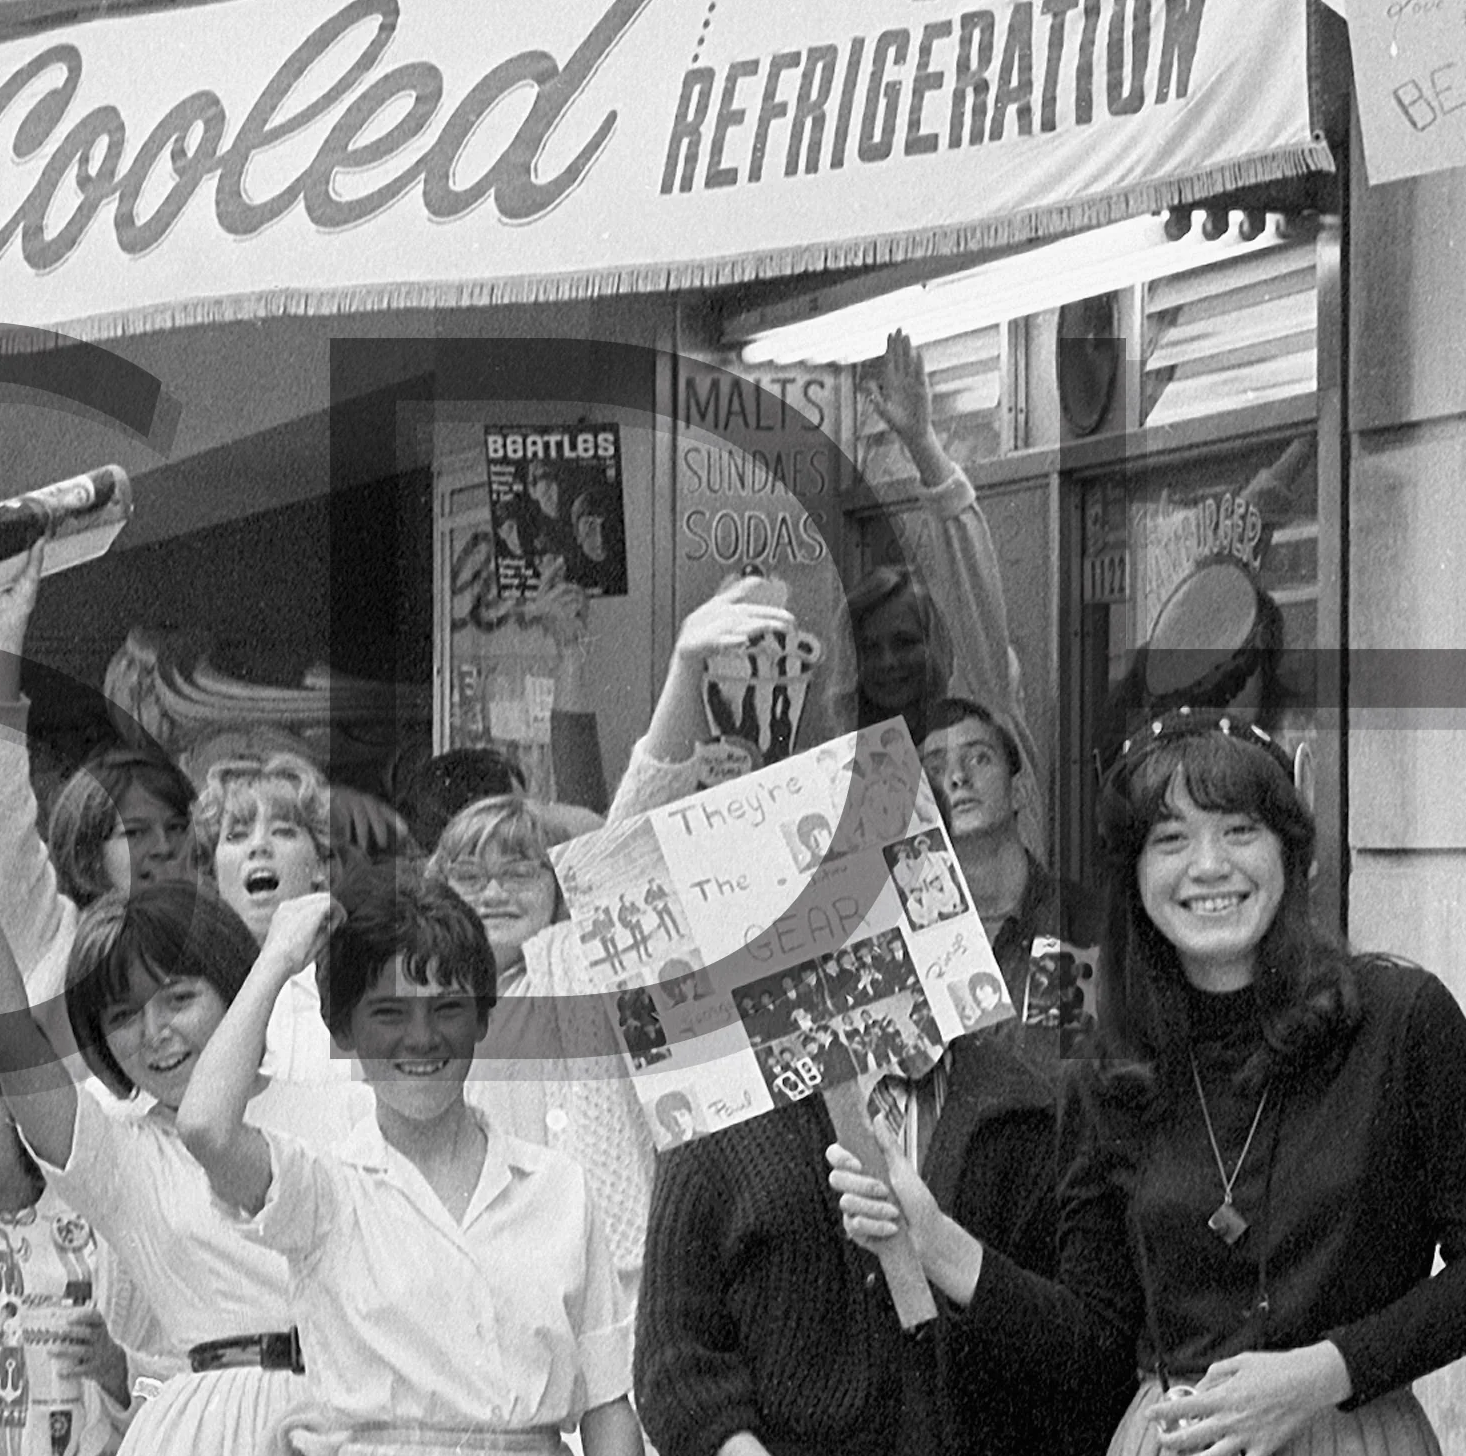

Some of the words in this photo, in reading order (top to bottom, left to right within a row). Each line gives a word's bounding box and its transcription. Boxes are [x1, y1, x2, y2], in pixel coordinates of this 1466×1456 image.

[684, 375, 828, 433] MALTS
[486, 432, 616, 460] BEATLES
[683, 447, 830, 499] SUNDAES
[683, 509, 830, 566] SODAS
[668, 773, 804, 839] They're
[689, 874, 750, 903] The
[743, 896, 871, 963] GEAR
